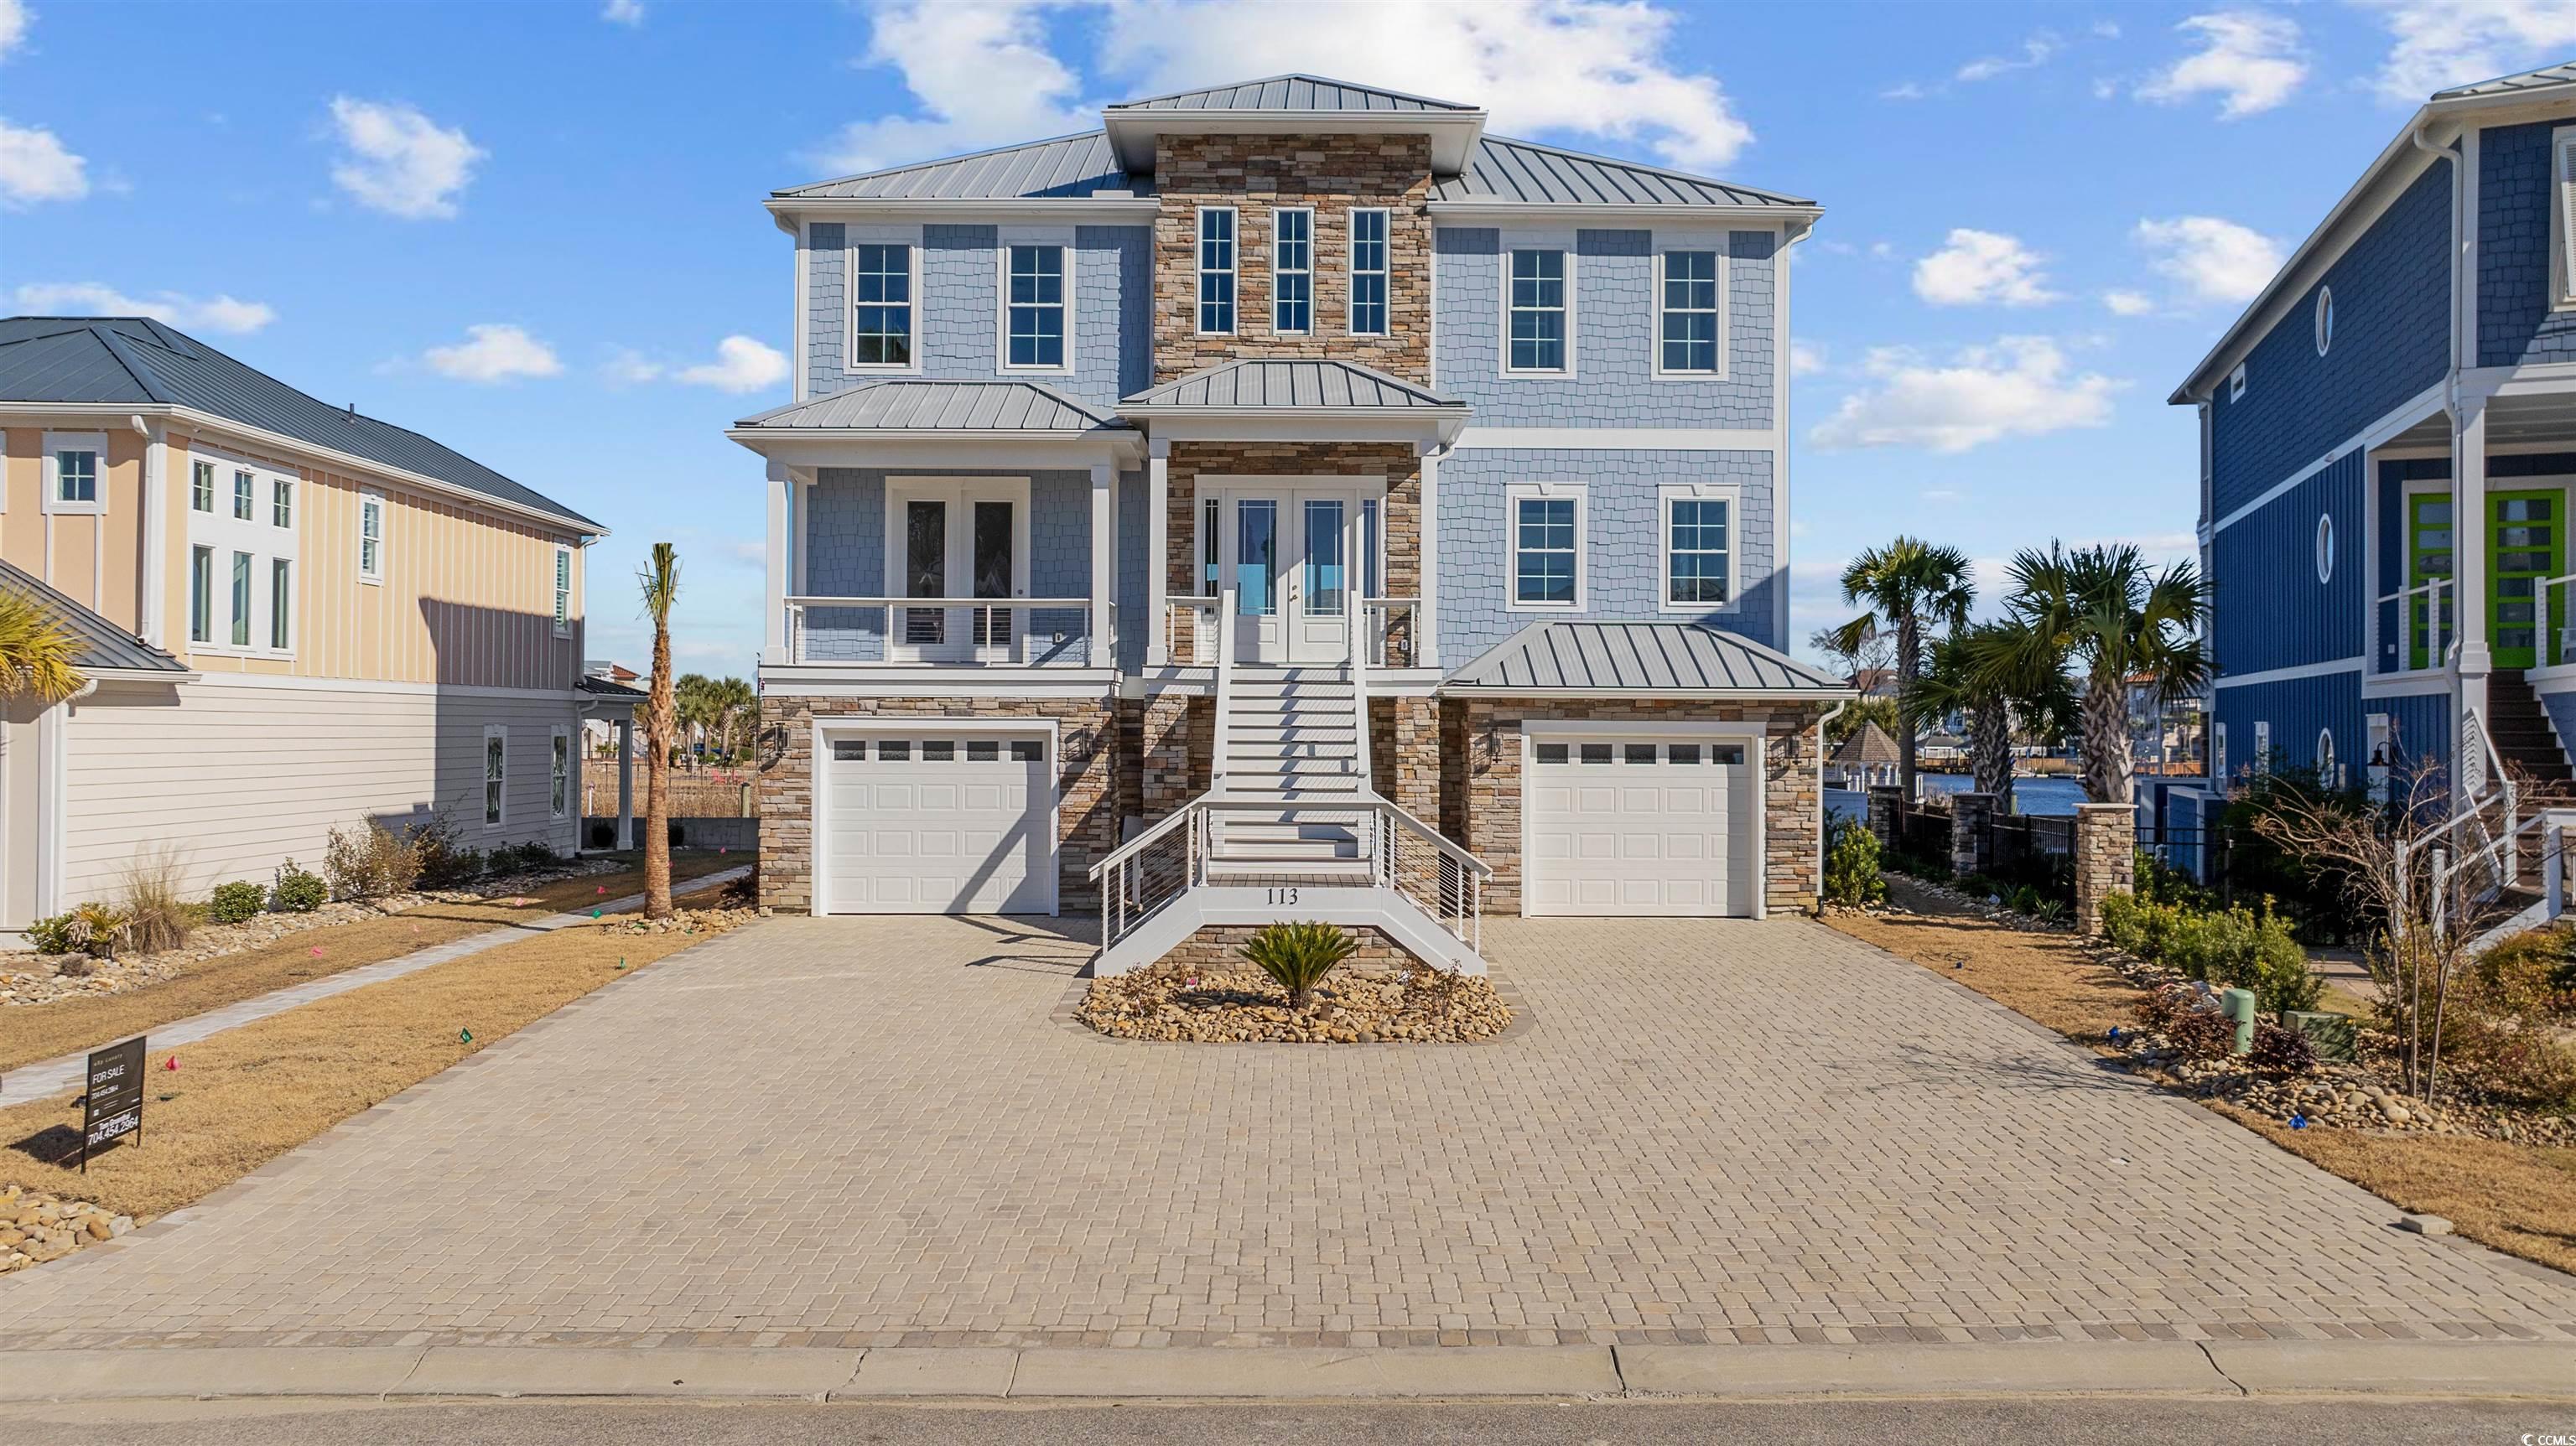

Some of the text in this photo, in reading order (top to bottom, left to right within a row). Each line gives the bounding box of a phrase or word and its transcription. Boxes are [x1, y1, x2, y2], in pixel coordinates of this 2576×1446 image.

[1267, 888, 1298, 905] 113
[92, 1064, 126, 1085] FOR SALE
[88, 1115, 139, 1146] 704.454.2964
